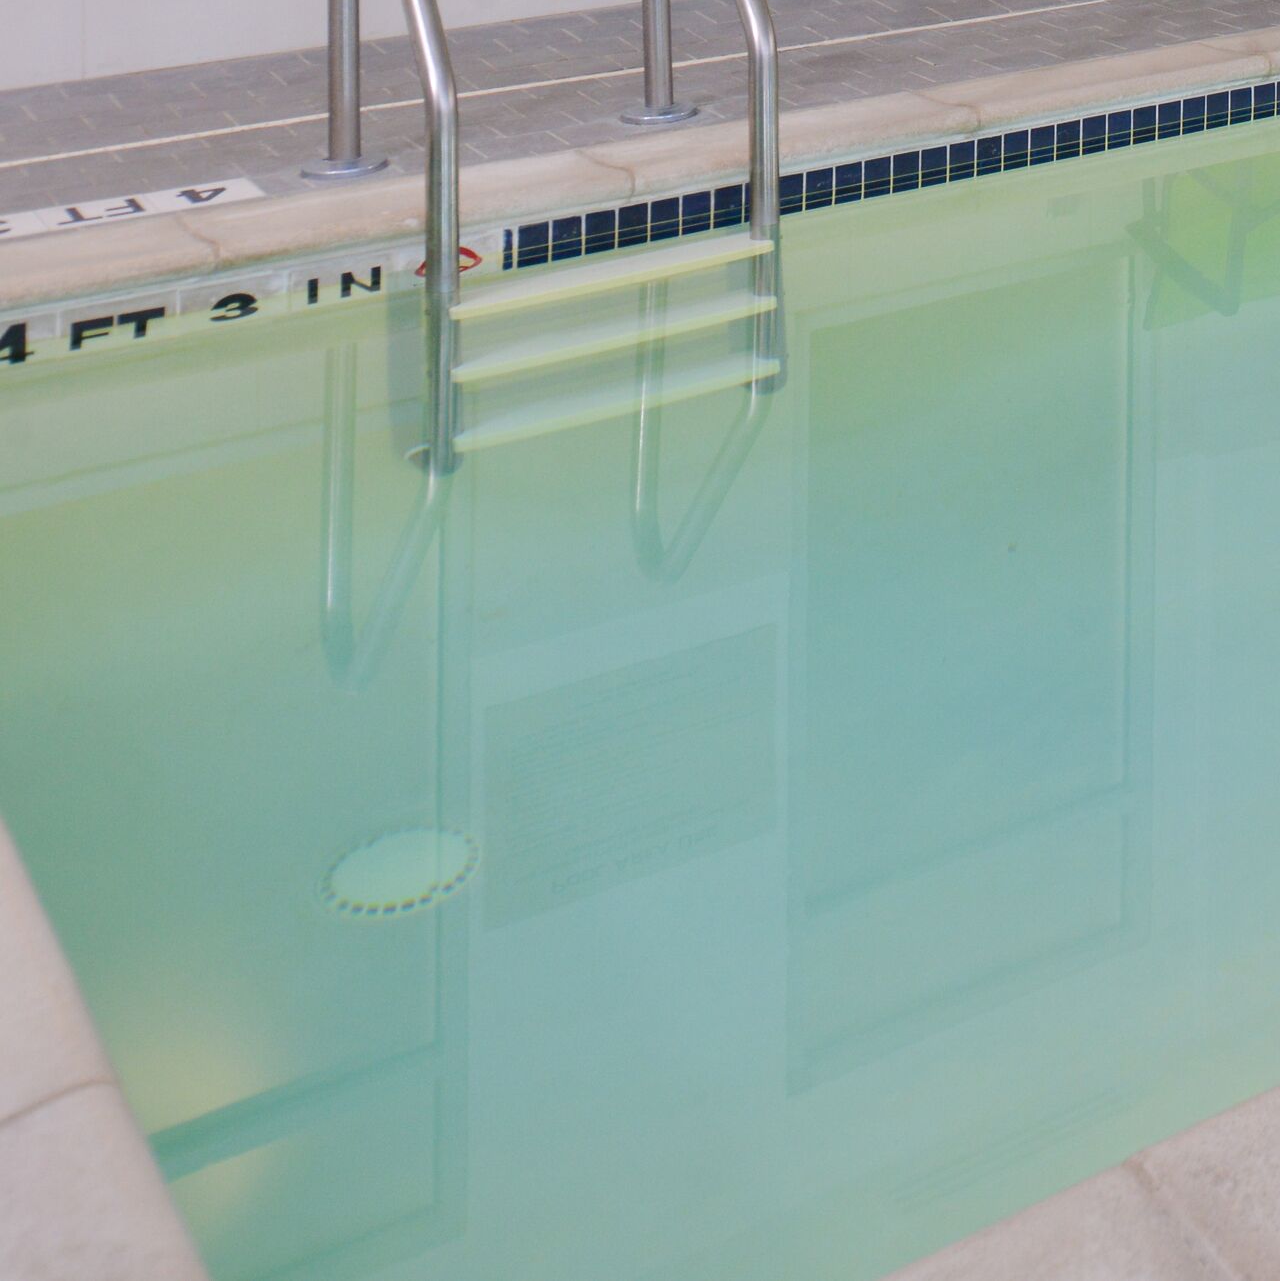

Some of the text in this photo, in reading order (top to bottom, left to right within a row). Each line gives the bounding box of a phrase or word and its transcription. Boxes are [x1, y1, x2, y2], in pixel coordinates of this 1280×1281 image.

[57, 187, 226, 226] 4 FT
[70, 307, 165, 351] FT
[306, 266, 381, 304] IN
